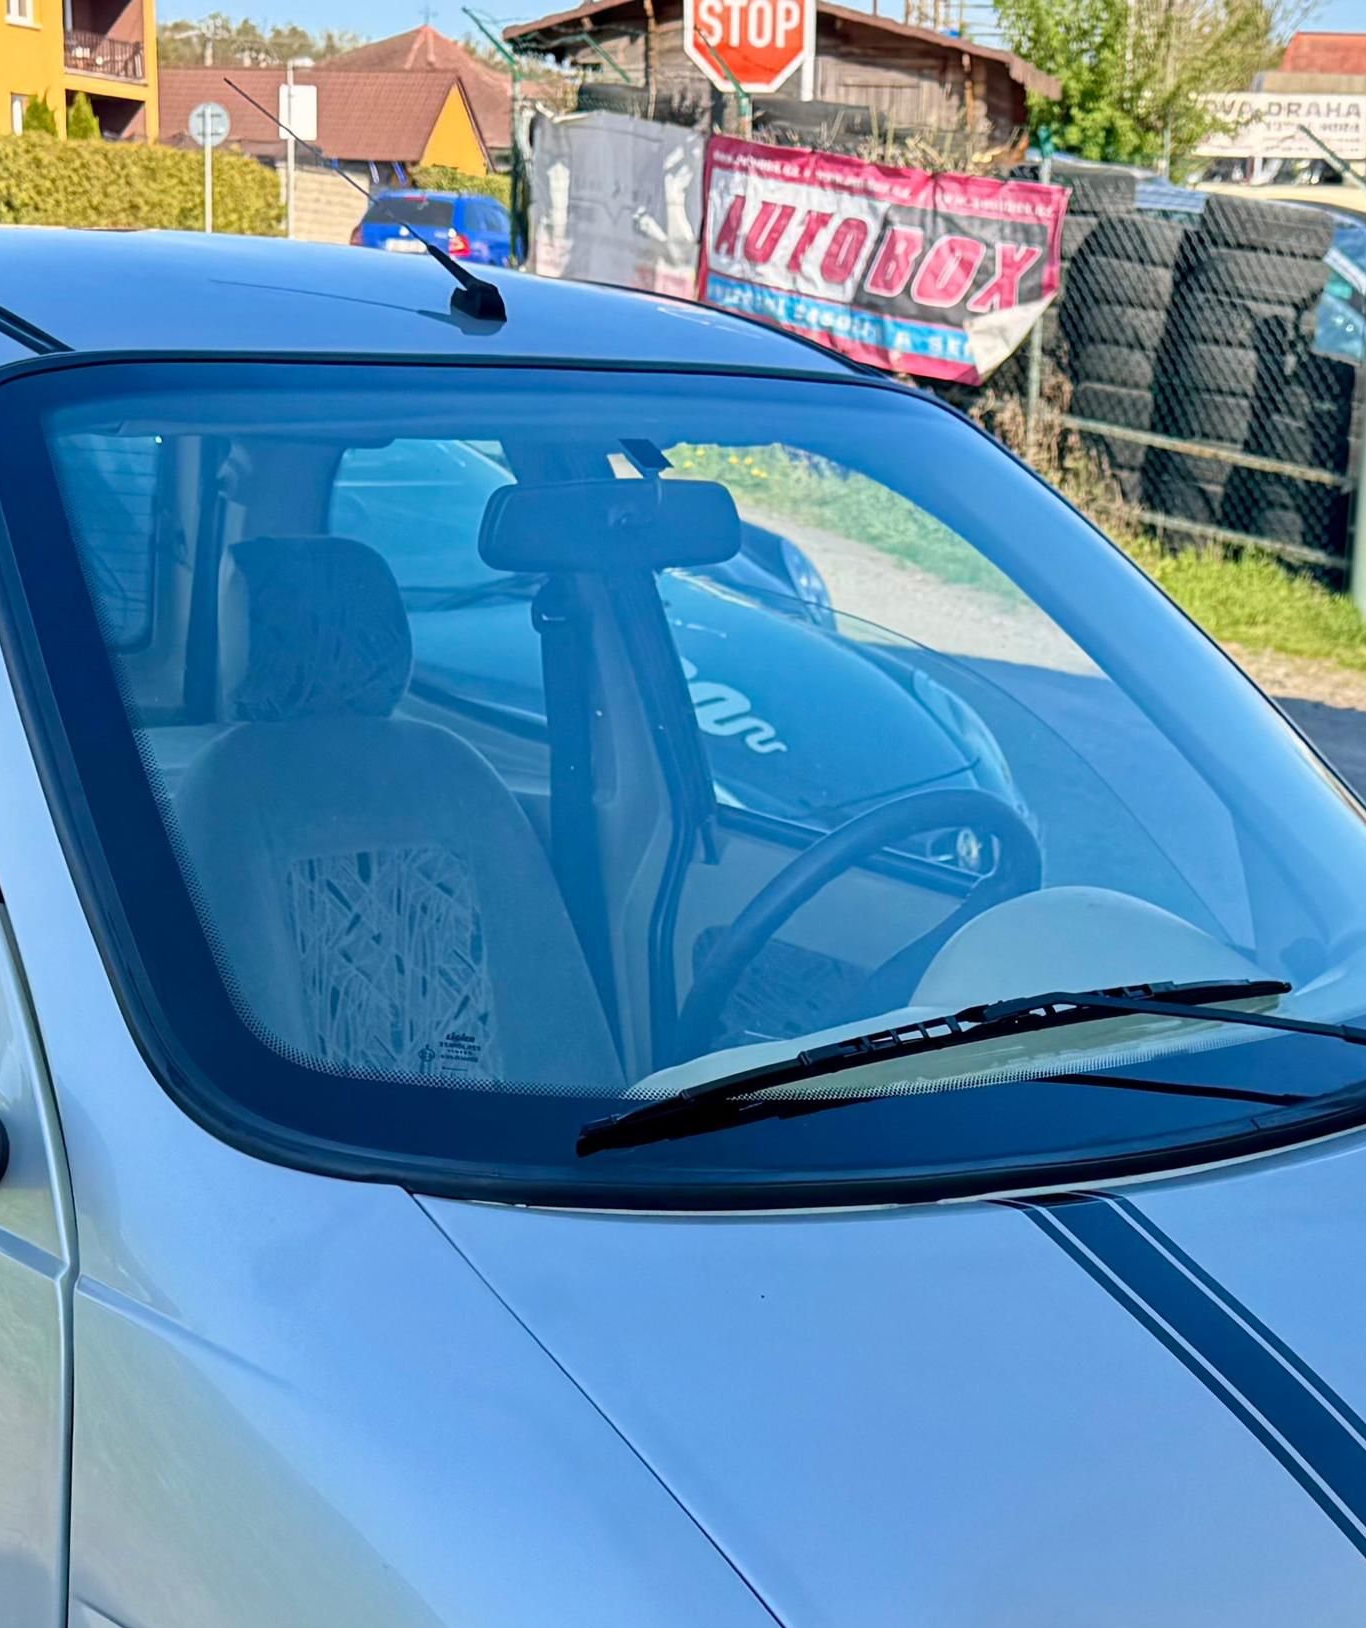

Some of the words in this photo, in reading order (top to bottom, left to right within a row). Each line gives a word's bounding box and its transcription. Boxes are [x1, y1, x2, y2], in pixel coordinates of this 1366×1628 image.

[697, 0, 801, 48] STOP
[1267, 101, 1362, 118] DRAHA
[715, 194, 1042, 313] AUTOBOX
